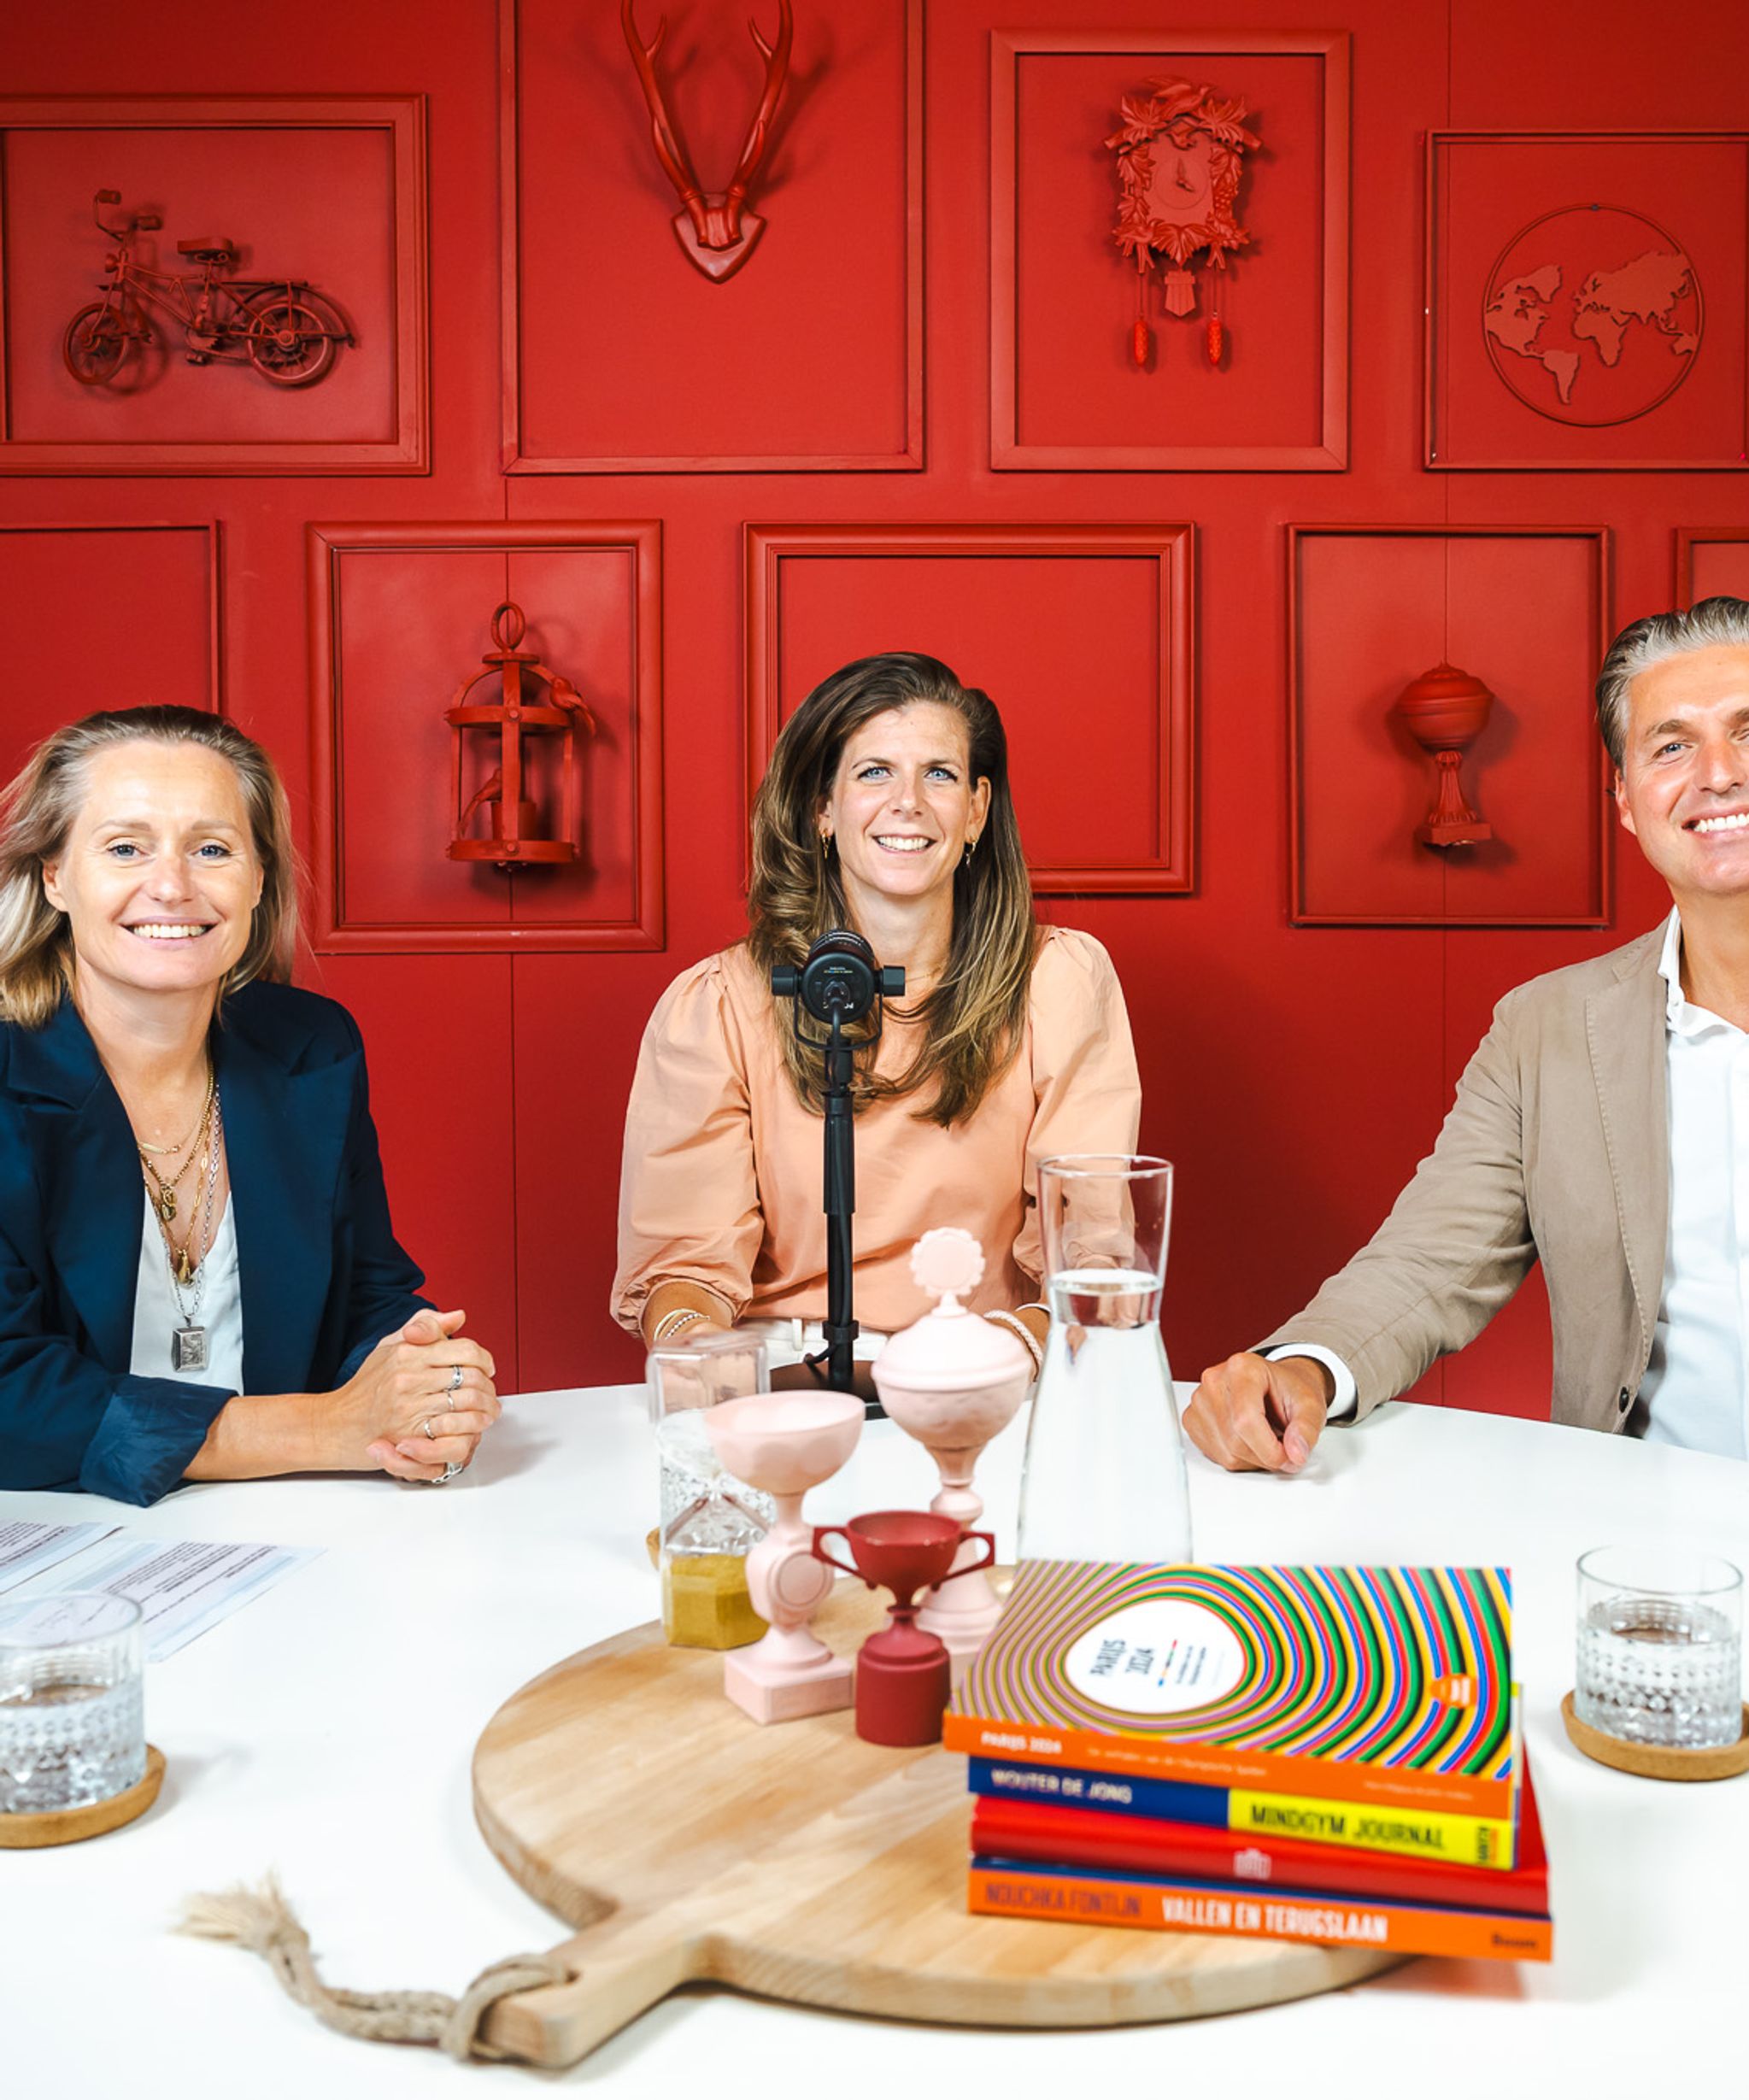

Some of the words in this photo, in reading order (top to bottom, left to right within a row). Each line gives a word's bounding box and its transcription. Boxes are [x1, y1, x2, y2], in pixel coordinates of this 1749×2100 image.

[991, 1769, 1059, 1793] WOUTER
[1062, 1776, 1083, 1797] DE
[1089, 1781, 1132, 1804] JONG
[1252, 1804, 1345, 1834] MINDGYM
[1353, 1817, 1445, 1849] JOURNAL
[1162, 1896, 1231, 1927] VALLEN
[1235, 1902, 1261, 1929] EN
[1265, 1904, 1388, 1943] TERUGSLAAN
